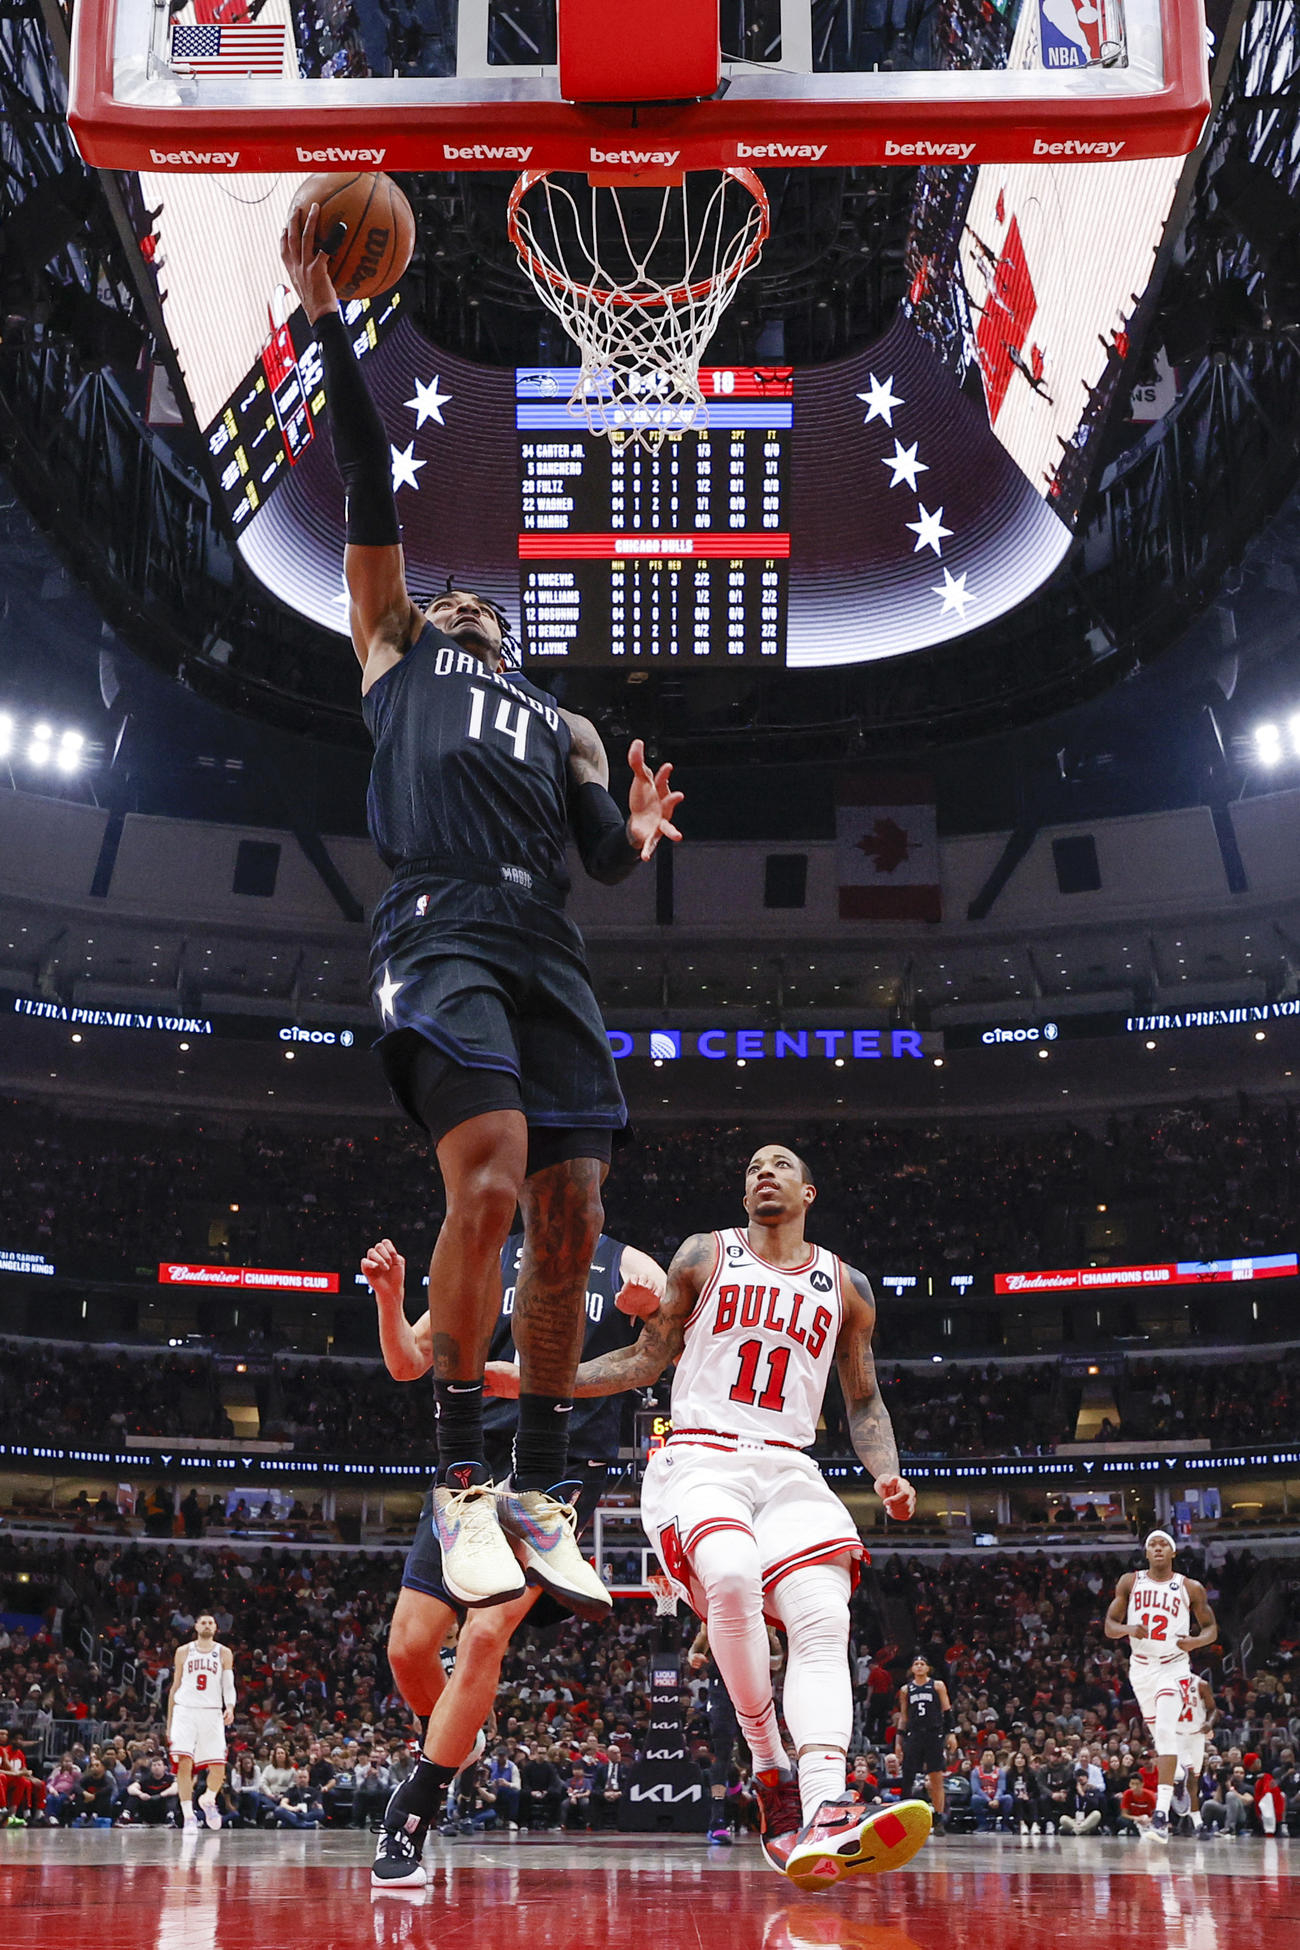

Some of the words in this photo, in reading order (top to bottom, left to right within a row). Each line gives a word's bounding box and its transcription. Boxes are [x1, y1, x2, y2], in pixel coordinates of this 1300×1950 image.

[1049, 47, 1079, 66] NBA
[296, 147, 386, 164] betway
[443, 145, 533, 162] betway
[737, 142, 827, 160] betway
[884, 140, 975, 158] betway
[1033, 139, 1125, 156] betway
[150, 149, 239, 167] betway
[590, 148, 680, 166] betway
[434, 648, 559, 731] ORLANDO
[468, 686, 530, 760] 14
[14, 998, 68, 1019] ULTRA
[71, 1011, 152, 1030] PREMIUM
[157, 1016, 212, 1034] VODKA
[1127, 1014, 1181, 1031] ULTRA
[1186, 1004, 1268, 1027] PREMIUM
[697, 1030, 923, 1059] CENTER
[31, 1263, 54, 1276] KINGS
[168, 1266, 239, 1282] Budweiser
[245, 1273, 302, 1287] CHAMPIONS
[303, 1277, 329, 1289] CLUB
[1005, 1275, 1077, 1290] Budweiser
[1082, 1271, 1142, 1285] CHAMPIONS
[1143, 1269, 1170, 1281] CLUB
[712, 1284, 833, 1359] BULLS
[729, 1339, 791, 1412] 11
[1134, 1590, 1181, 1618] BULLS
[1141, 1613, 1168, 1641] 12
[187, 1658, 218, 1675] BULLS
[196, 1674, 208, 1691] 9
[918, 1702, 926, 1716] 5
[646, 1749, 684, 1760] KIA
[630, 1784, 702, 1802] KIA
